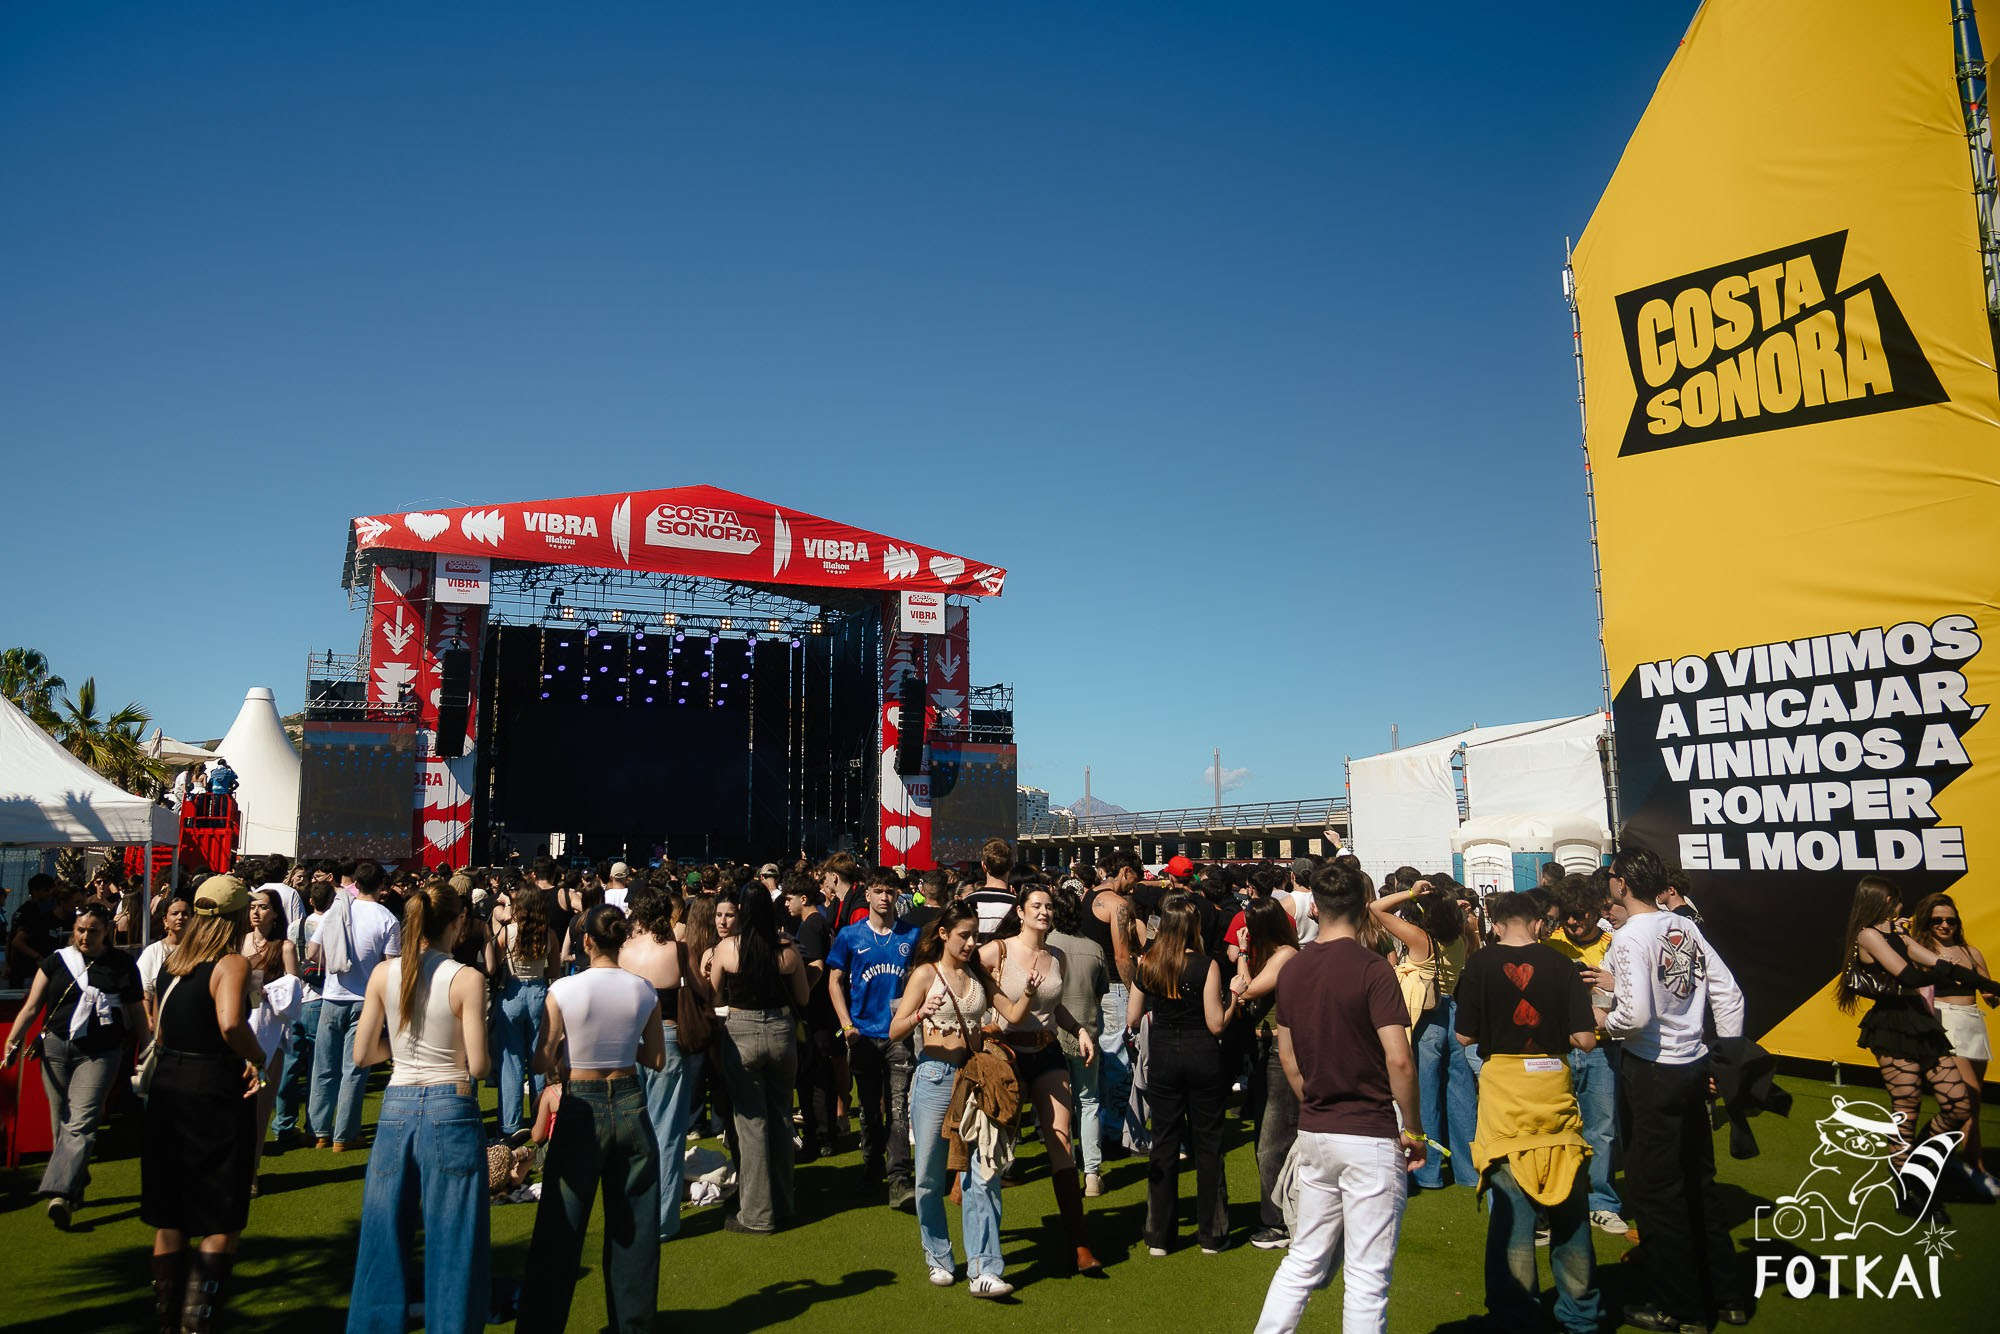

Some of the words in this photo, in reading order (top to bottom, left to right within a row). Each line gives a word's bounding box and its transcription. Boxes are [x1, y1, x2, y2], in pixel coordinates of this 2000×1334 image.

[1637, 254, 1826, 388] COSTA
[1646, 288, 1894, 435] SONORA
[522, 511, 598, 538] VIBRA
[657, 505, 739, 526] COSTA
[544, 534, 576, 546] Mahou
[657, 519, 760, 543] SONORA
[803, 537, 870, 562] VIBRA
[822, 561, 850, 571] Mahou
[447, 578, 480, 589] VIBRA
[910, 610, 937, 620] VIBRA
[1638, 656, 1709, 700] NO
[1714, 614, 1982, 688] VINIMOS
[1655, 702, 1691, 740] A
[1696, 670, 1988, 736] ENCAJAR,
[1661, 728, 1906, 782] VINIMOS
[1915, 723, 1970, 767] A
[414, 772, 443, 786] BRA
[906, 783, 929, 796] VIB
[1689, 777, 1938, 825] ROMPER
[1678, 832, 1741, 871] EL
[1746, 827, 1967, 872] MOLDE
